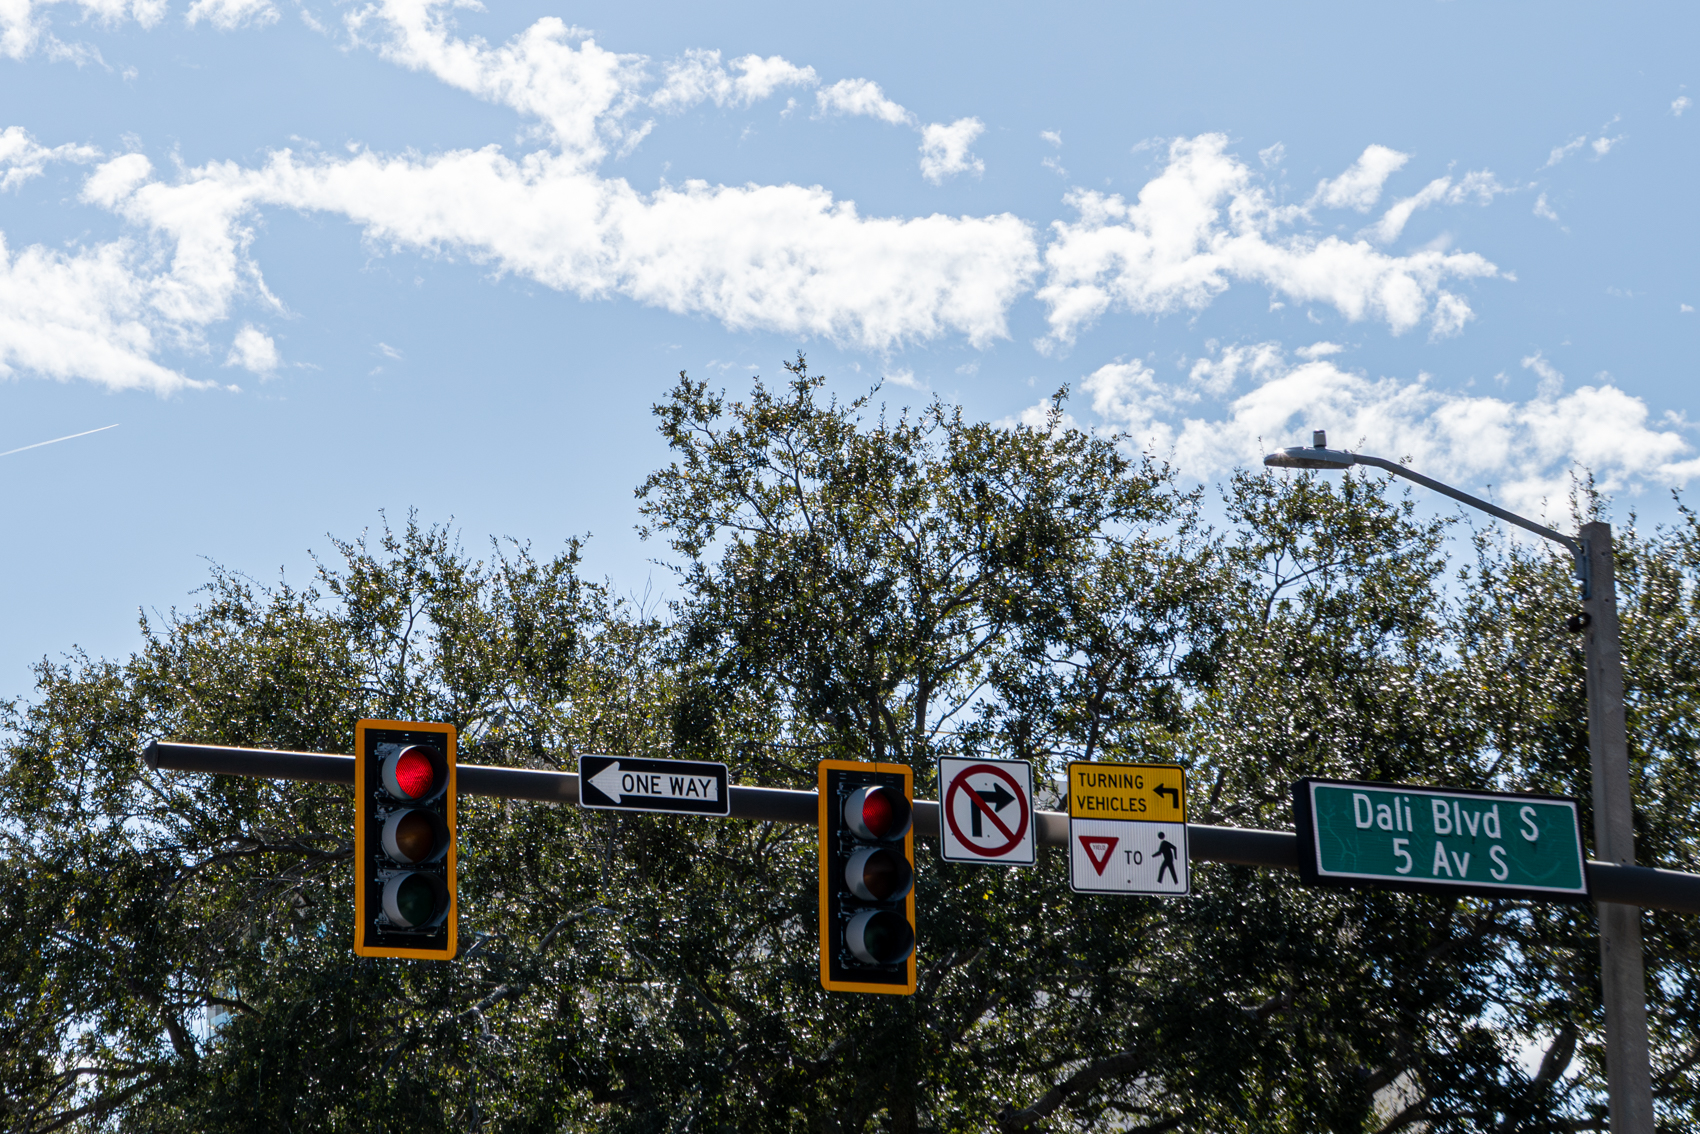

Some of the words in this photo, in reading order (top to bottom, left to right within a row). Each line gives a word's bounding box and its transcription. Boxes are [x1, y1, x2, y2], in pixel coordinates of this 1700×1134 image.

[622, 773, 662, 795] ONE
[669, 776, 712, 798] WAY
[1078, 772, 1144, 790] TURNING
[1077, 795, 1147, 812] VEHICLES
[1353, 793, 1413, 833] Dali
[1431, 798, 1502, 839] Blvd
[1520, 805, 1539, 843] S
[1124, 850, 1143, 866] TO
[1393, 838, 1412, 875] 5
[1432, 841, 1470, 879] Av
[1489, 845, 1509, 881] S
